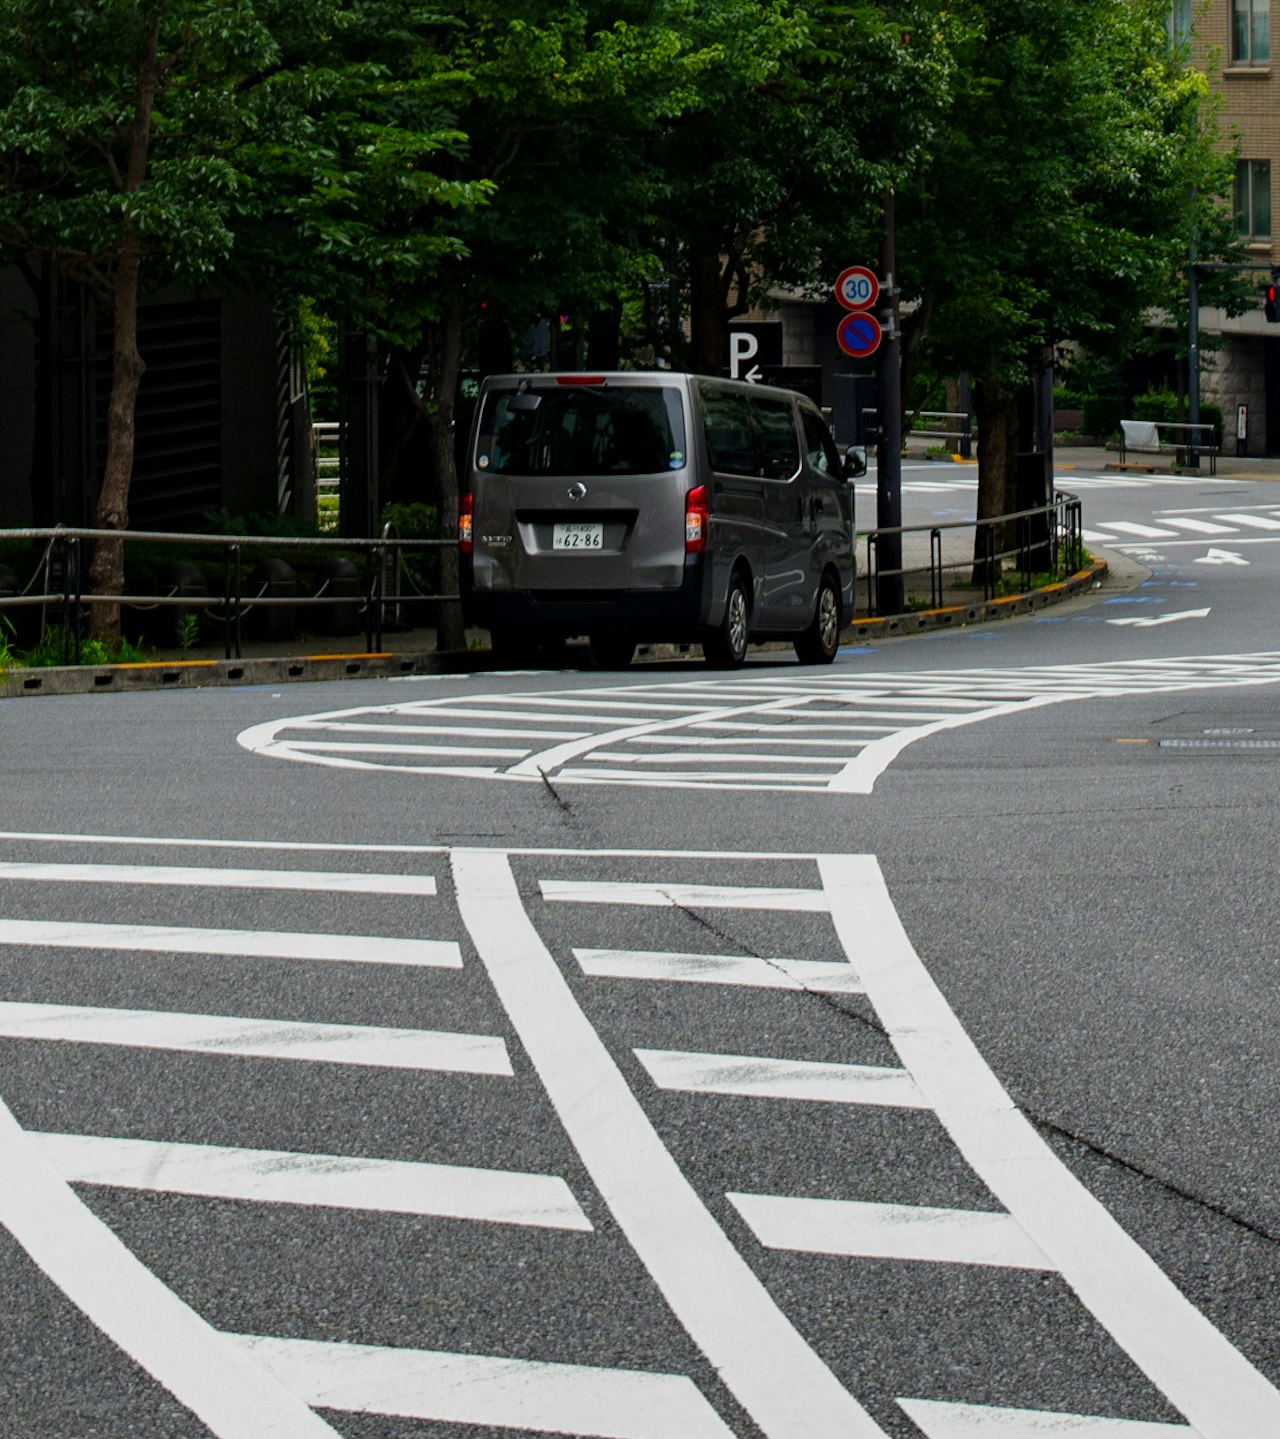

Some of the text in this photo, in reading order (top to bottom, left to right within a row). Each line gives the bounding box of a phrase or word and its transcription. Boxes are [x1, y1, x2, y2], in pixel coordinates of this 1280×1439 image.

[846, 279, 869, 299] 30
[729, 331, 759, 379] P
[564, 533, 600, 547] 62-86
